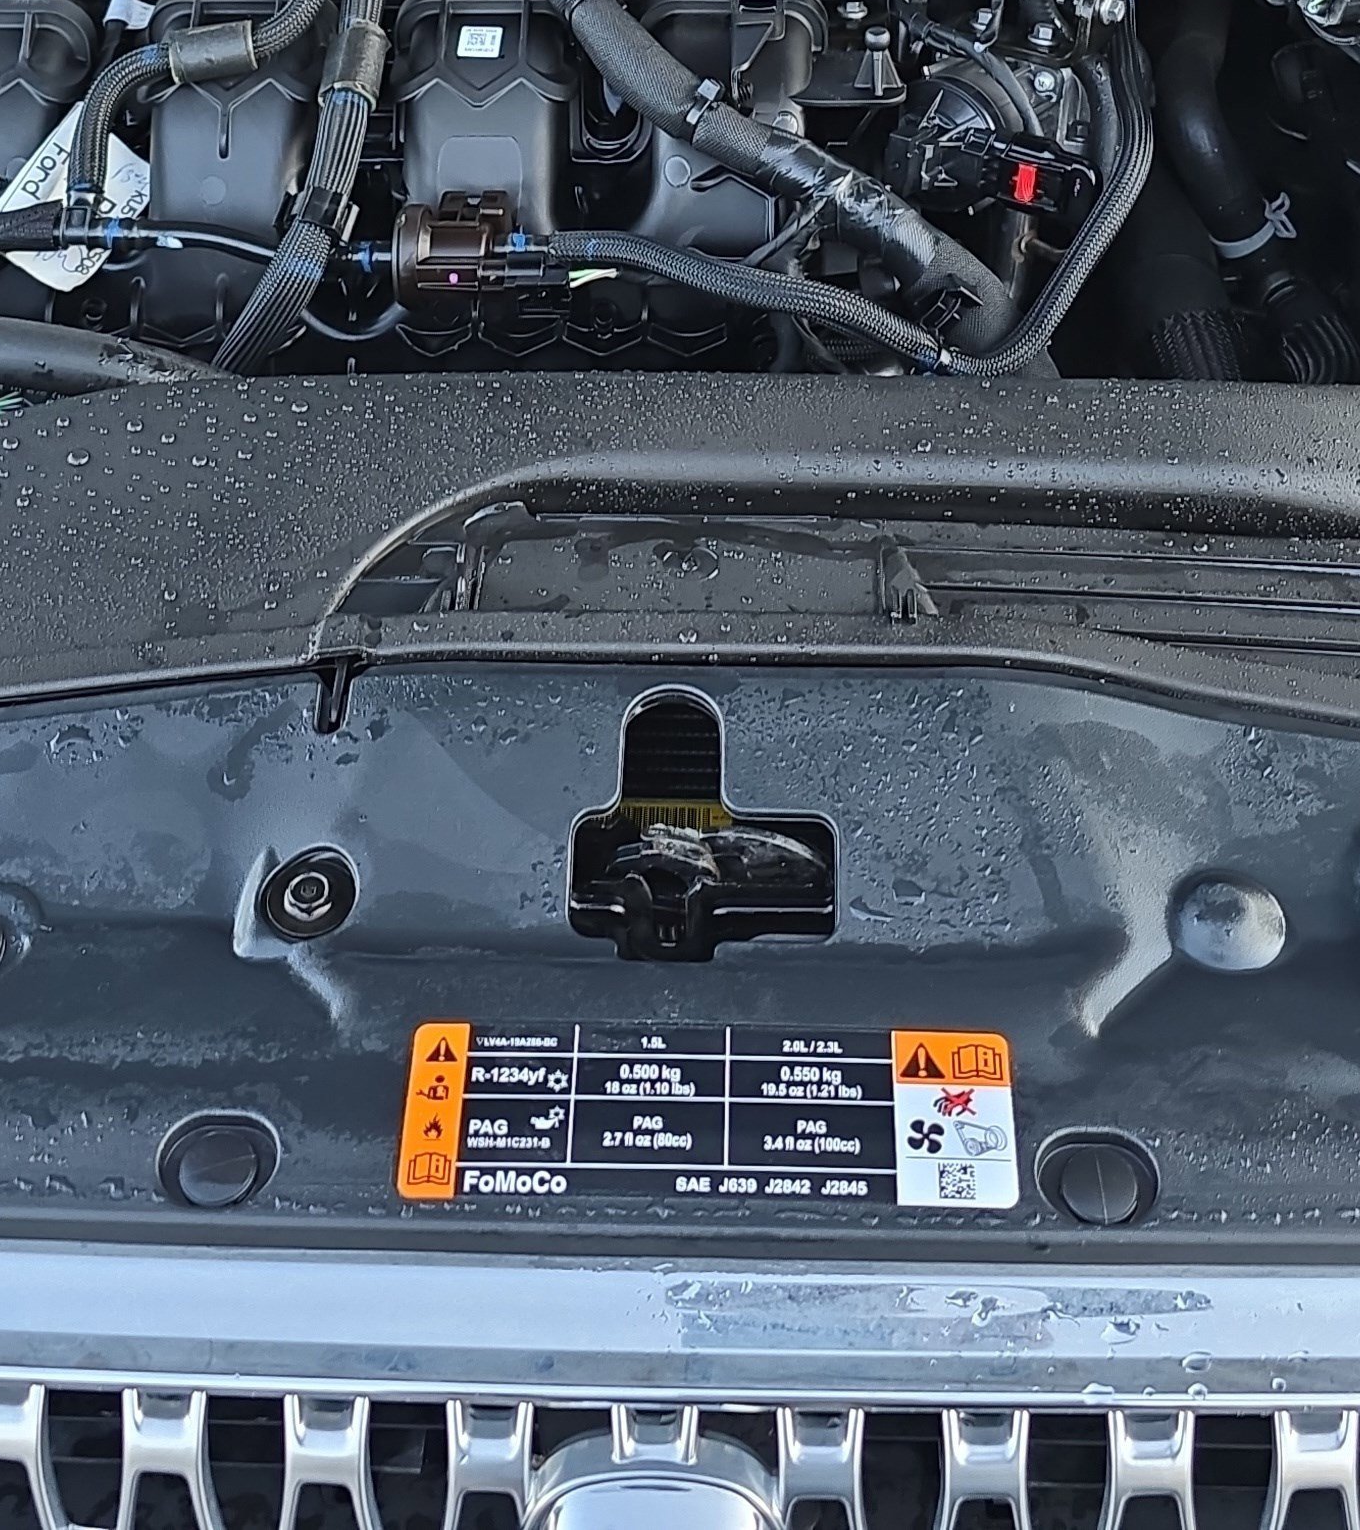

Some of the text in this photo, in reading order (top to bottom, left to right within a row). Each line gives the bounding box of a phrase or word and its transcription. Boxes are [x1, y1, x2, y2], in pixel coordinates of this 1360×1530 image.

[21, 141, 71, 201] Ford
[640, 1036, 667, 1049] 1.5L
[782, 1039, 808, 1053] 2.0L
[816, 1041, 843, 1054] 2.3L
[471, 1067, 545, 1085] R-1234yf
[619, 1064, 681, 1082] 0.500 kg
[780, 1065, 842, 1085] 0.550 kg
[604, 1081, 696, 1097] 18 oz (1.10 lbs)
[760, 1082, 863, 1100] 19.5 oz (1.21 lbs)
[468, 1119, 508, 1135] PAG
[632, 1115, 664, 1130] PAG
[796, 1119, 828, 1134] PAG
[602, 1131, 692, 1150] 2.7 fl oz (80cc)
[763, 1135, 861, 1155] 3.4 fl oz (100cc)
[462, 1170, 568, 1194] FoMoCo
[675, 1176, 869, 1197] SAE J639 J2842 J2845
